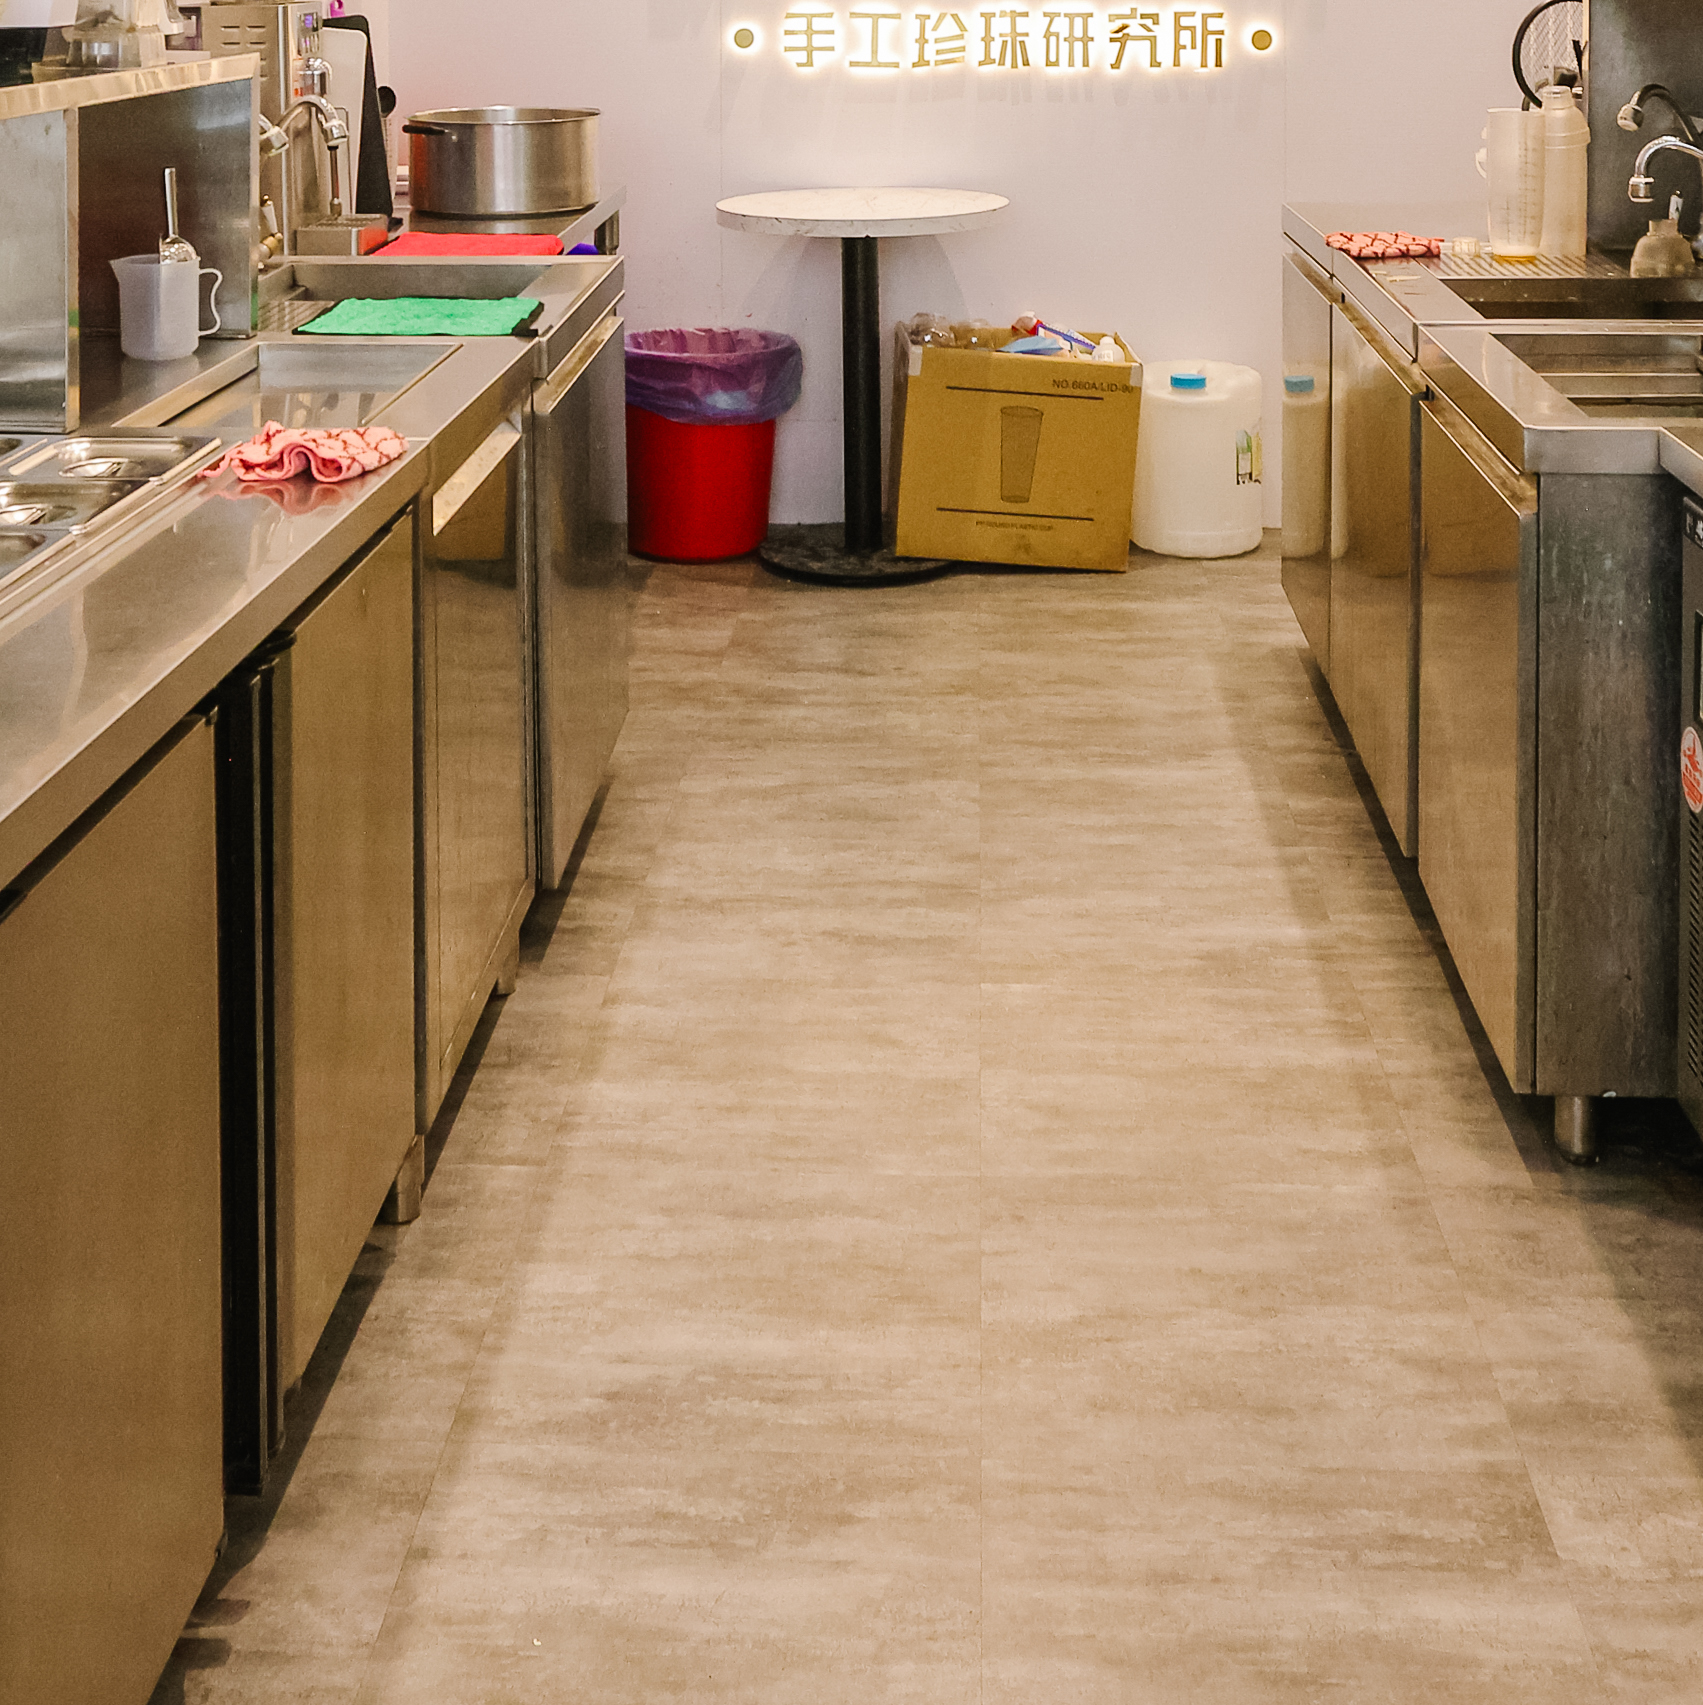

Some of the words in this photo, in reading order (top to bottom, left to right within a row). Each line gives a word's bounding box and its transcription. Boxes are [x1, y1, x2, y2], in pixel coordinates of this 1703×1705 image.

[782, 7, 1226, 70] 手工珍珠研究所
